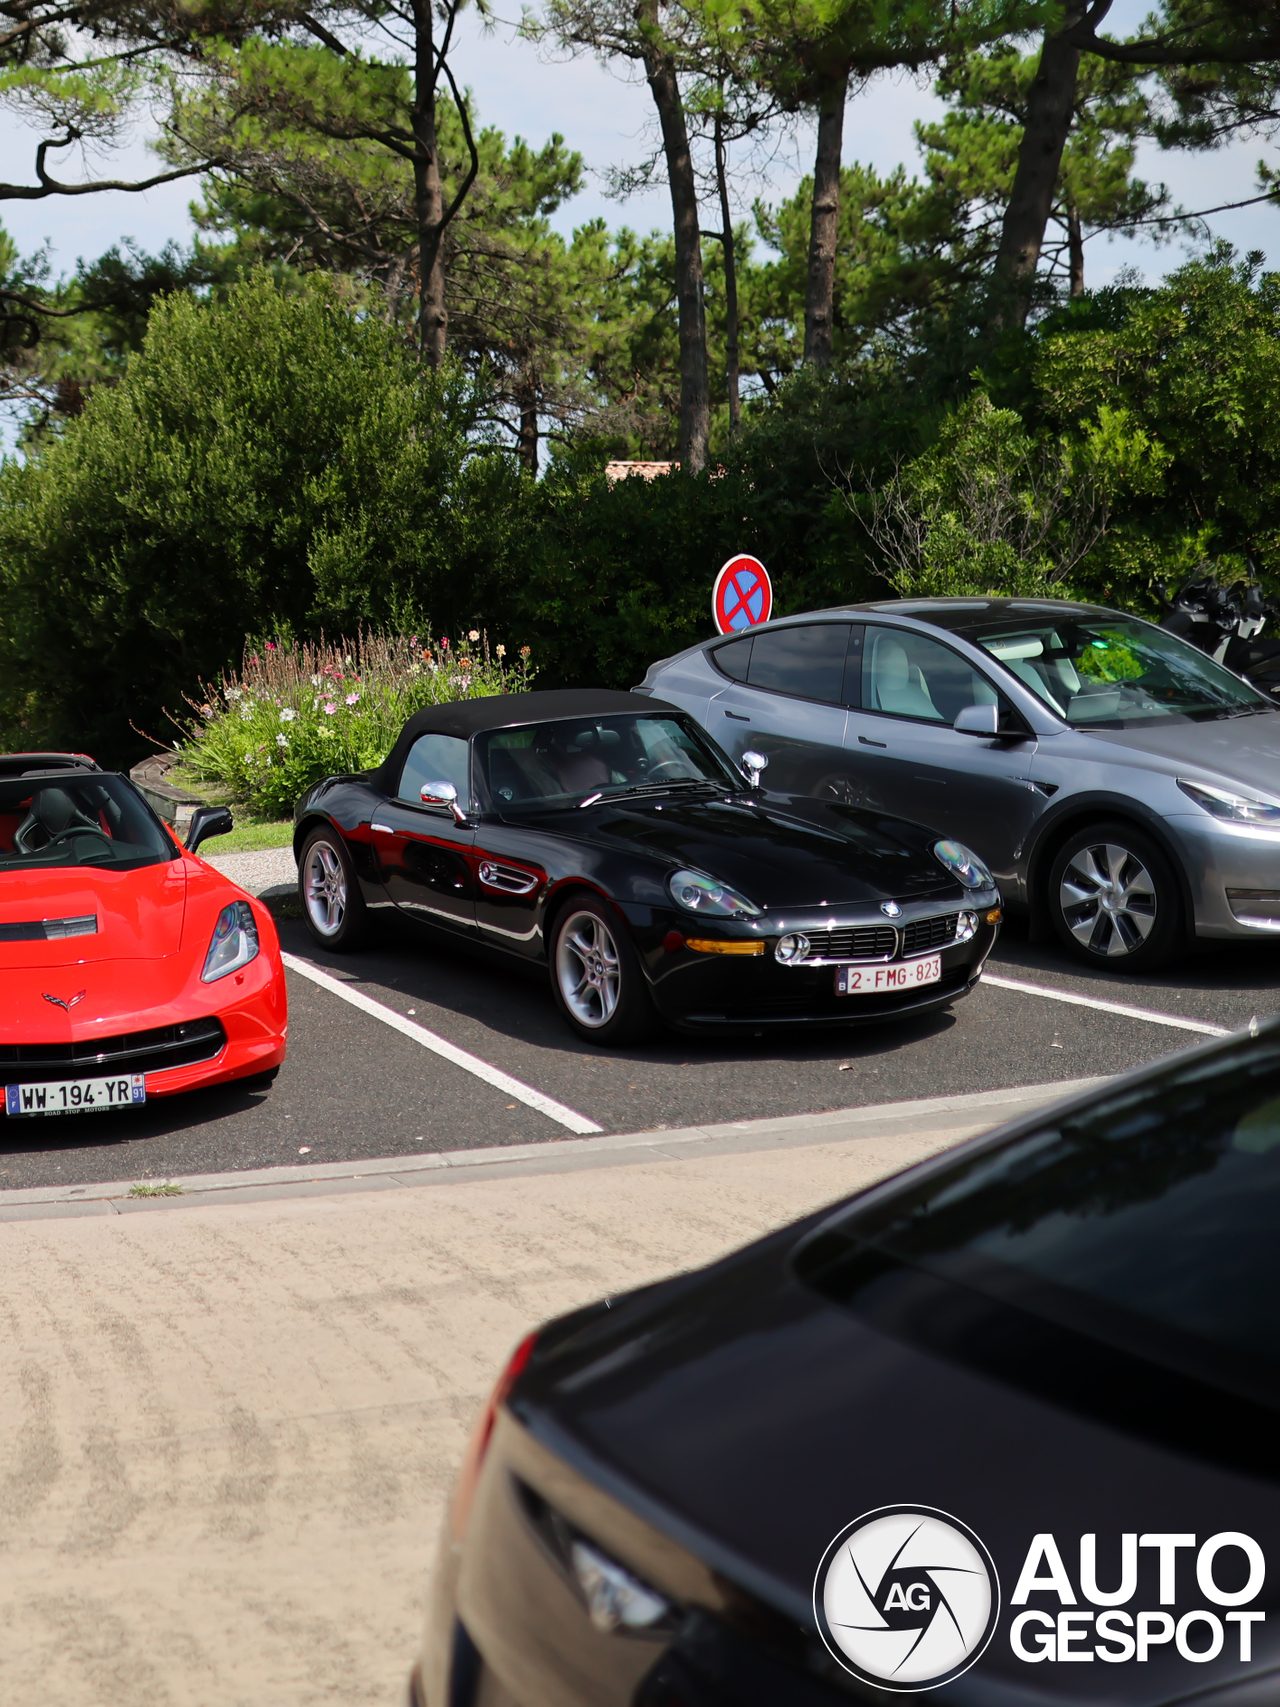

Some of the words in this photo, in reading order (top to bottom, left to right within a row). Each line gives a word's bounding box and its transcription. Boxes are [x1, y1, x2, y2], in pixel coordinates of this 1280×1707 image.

[838, 982, 846, 991] B
[851, 959, 939, 989] 2-FMG-823
[22, 1080, 129, 1110] WW-194-YR
[132, 1087, 144, 1099] 91
[84, 1106, 110, 1114] MOTORS
